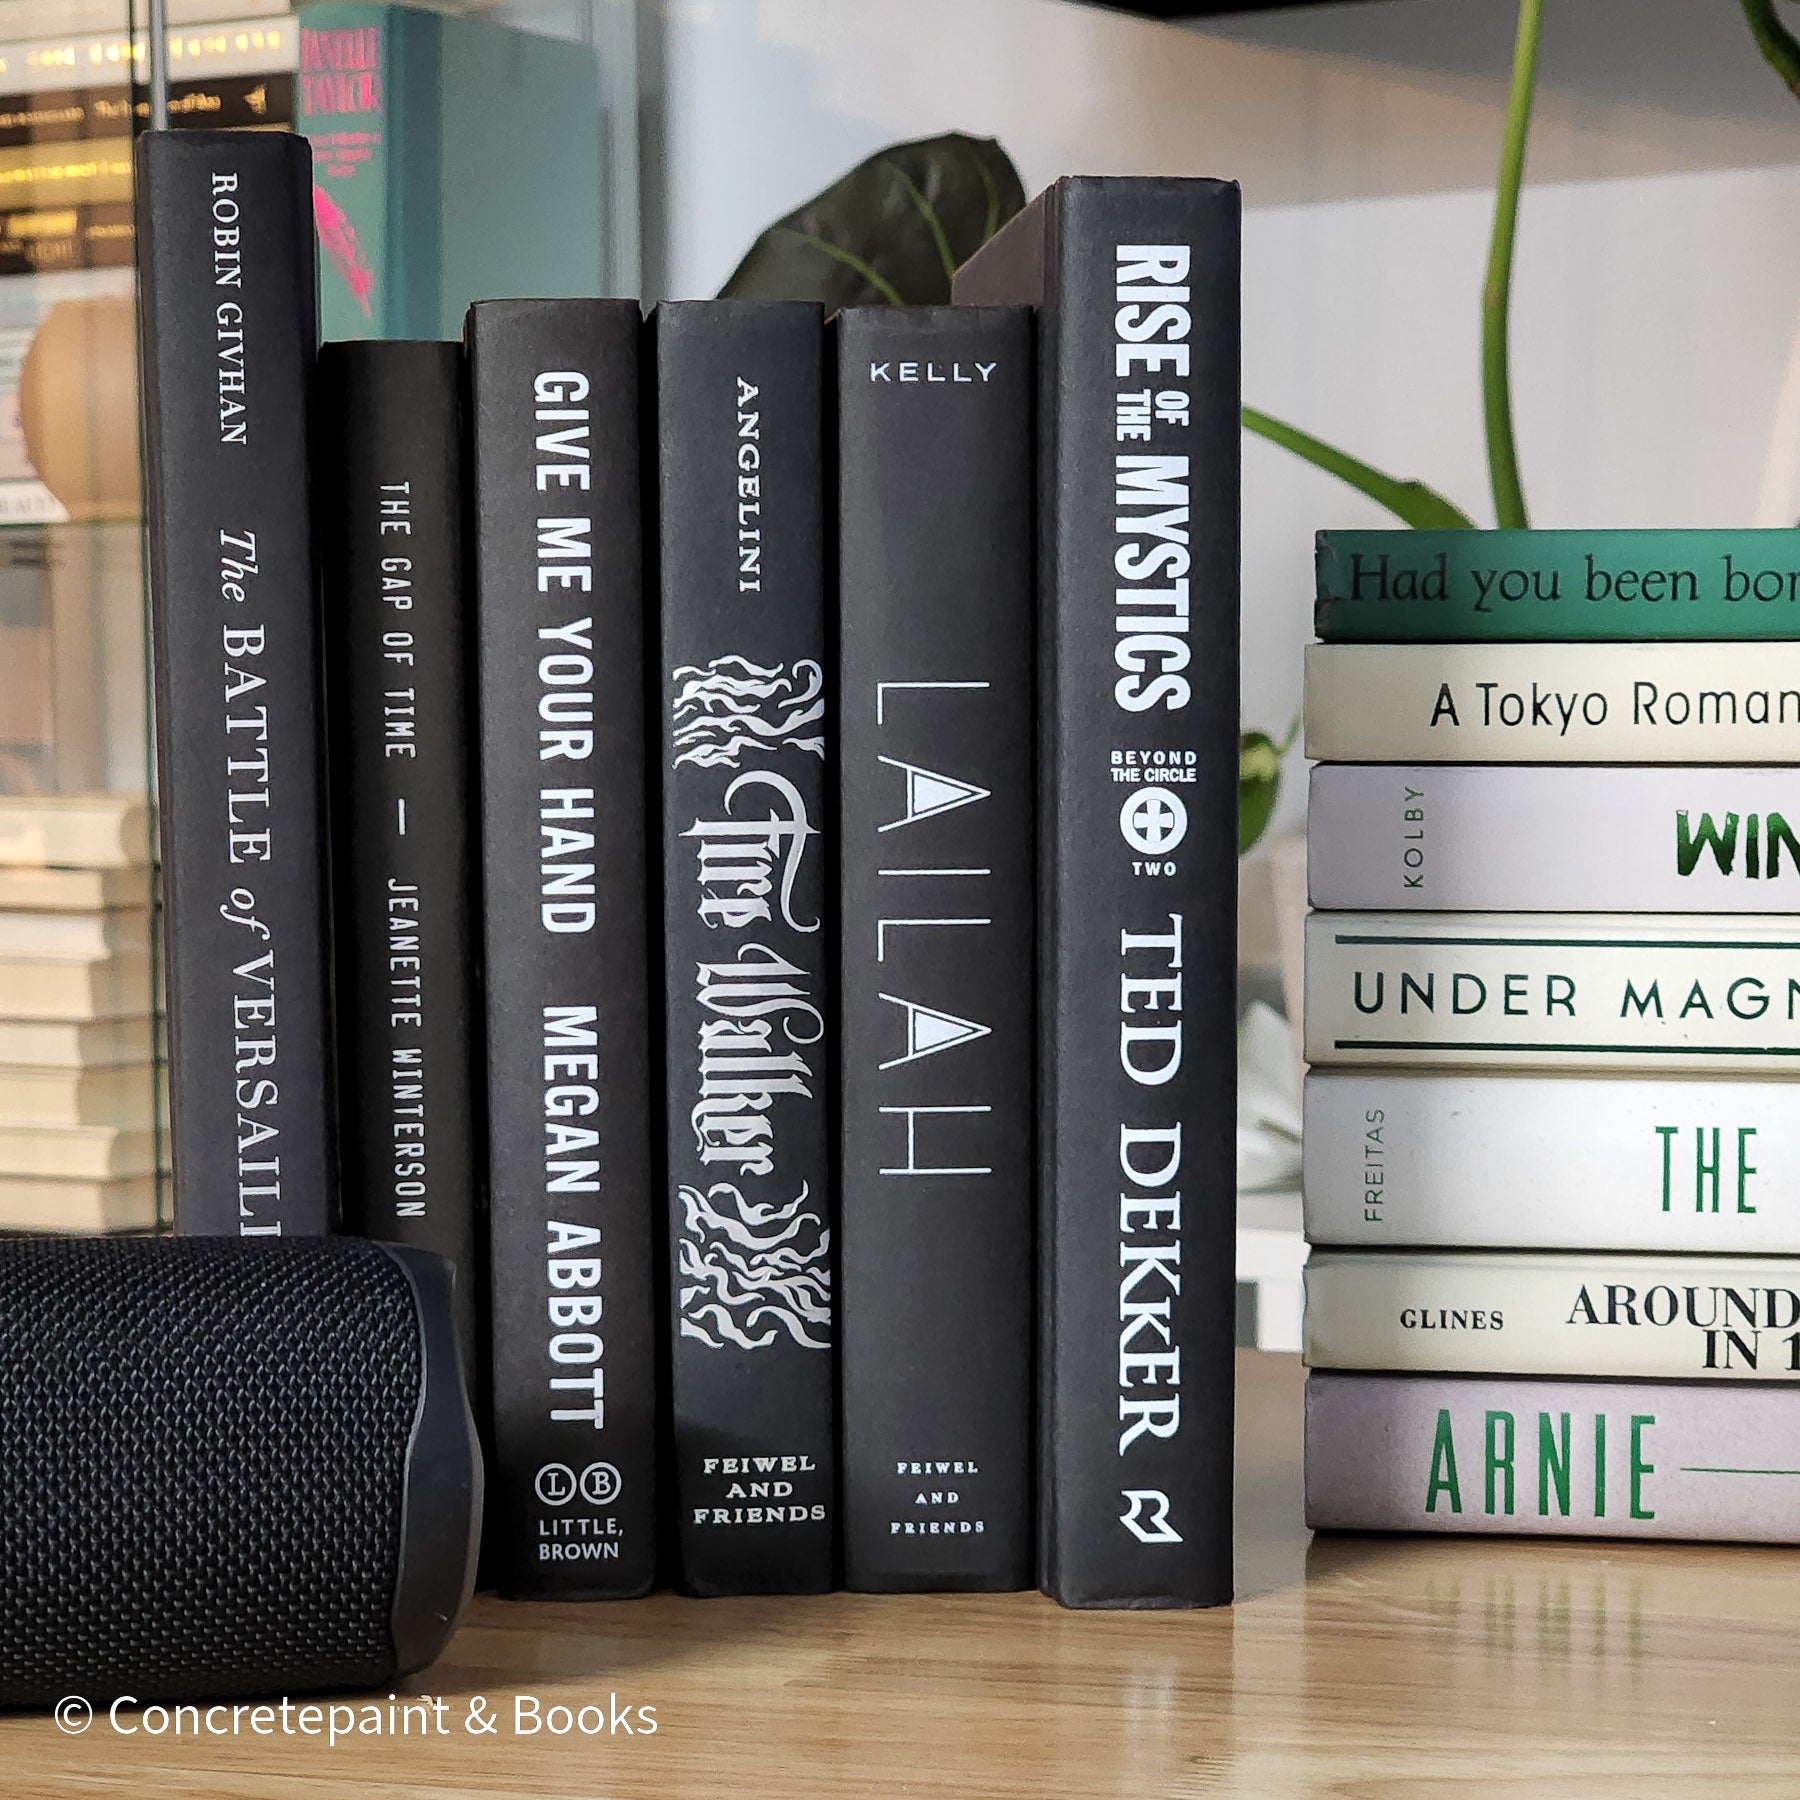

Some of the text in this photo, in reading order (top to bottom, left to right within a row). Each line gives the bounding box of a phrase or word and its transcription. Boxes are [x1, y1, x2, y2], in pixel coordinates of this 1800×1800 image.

[211, 172, 247, 445] ROBIN GIVHAN
[870, 362, 997, 382] KELLY
[736, 376, 761, 592] ANGELINI
[1114, 244, 1192, 713] RISE OF THE MYSTICS
[380, 481, 412, 536] THE
[220, 529, 259, 603] The
[380, 557, 413, 610] GAP
[1350, 553, 1449, 603] Had
[1469, 569, 1561, 615] you
[1584, 553, 1700, 603] been
[382, 632, 414, 667] OF
[533, 371, 596, 933] GIVE ME YOUR HAND
[384, 687, 416, 758] TIME
[1429, 681, 1800, 737] A Tokyo Roman
[223, 624, 271, 864] BATTLE
[1110, 750, 1197, 766] BEYOND
[1110, 767, 1197, 783] THE CIRCLE
[1403, 786, 1424, 888] KOLBY
[1131, 861, 1177, 877] TWO
[219, 888, 271, 941] of
[876, 681, 992, 1175] LAILAH
[387, 878, 422, 1028] JEANETTE
[1353, 970, 1576, 1017] UNDER
[392, 1048, 426, 1217] WINTERSON
[1118, 912, 1183, 1457] TED DEKKER
[1363, 1109, 1385, 1222] FREITAS
[1655, 1126, 1757, 1214] THE
[542, 1006, 604, 1430] MEGAN ABBOTT
[1399, 1308, 1504, 1331] GLINES
[1565, 1284, 1800, 1329] AROUND
[1702, 1329, 1761, 1370] IN
[703, 1455, 816, 1474] FEIWEL
[725, 1481, 793, 1499] AND
[896, 1461, 979, 1475] FEIWEL
[1421, 1408, 1656, 1523] ARNIE
[693, 1504, 826, 1524] FRIENDS
[914, 1491, 959, 1505] AND
[539, 1517, 623, 1537] LITTLE,
[539, 1541, 619, 1561] BROWN
[890, 1520, 985, 1534] FRIENDS
